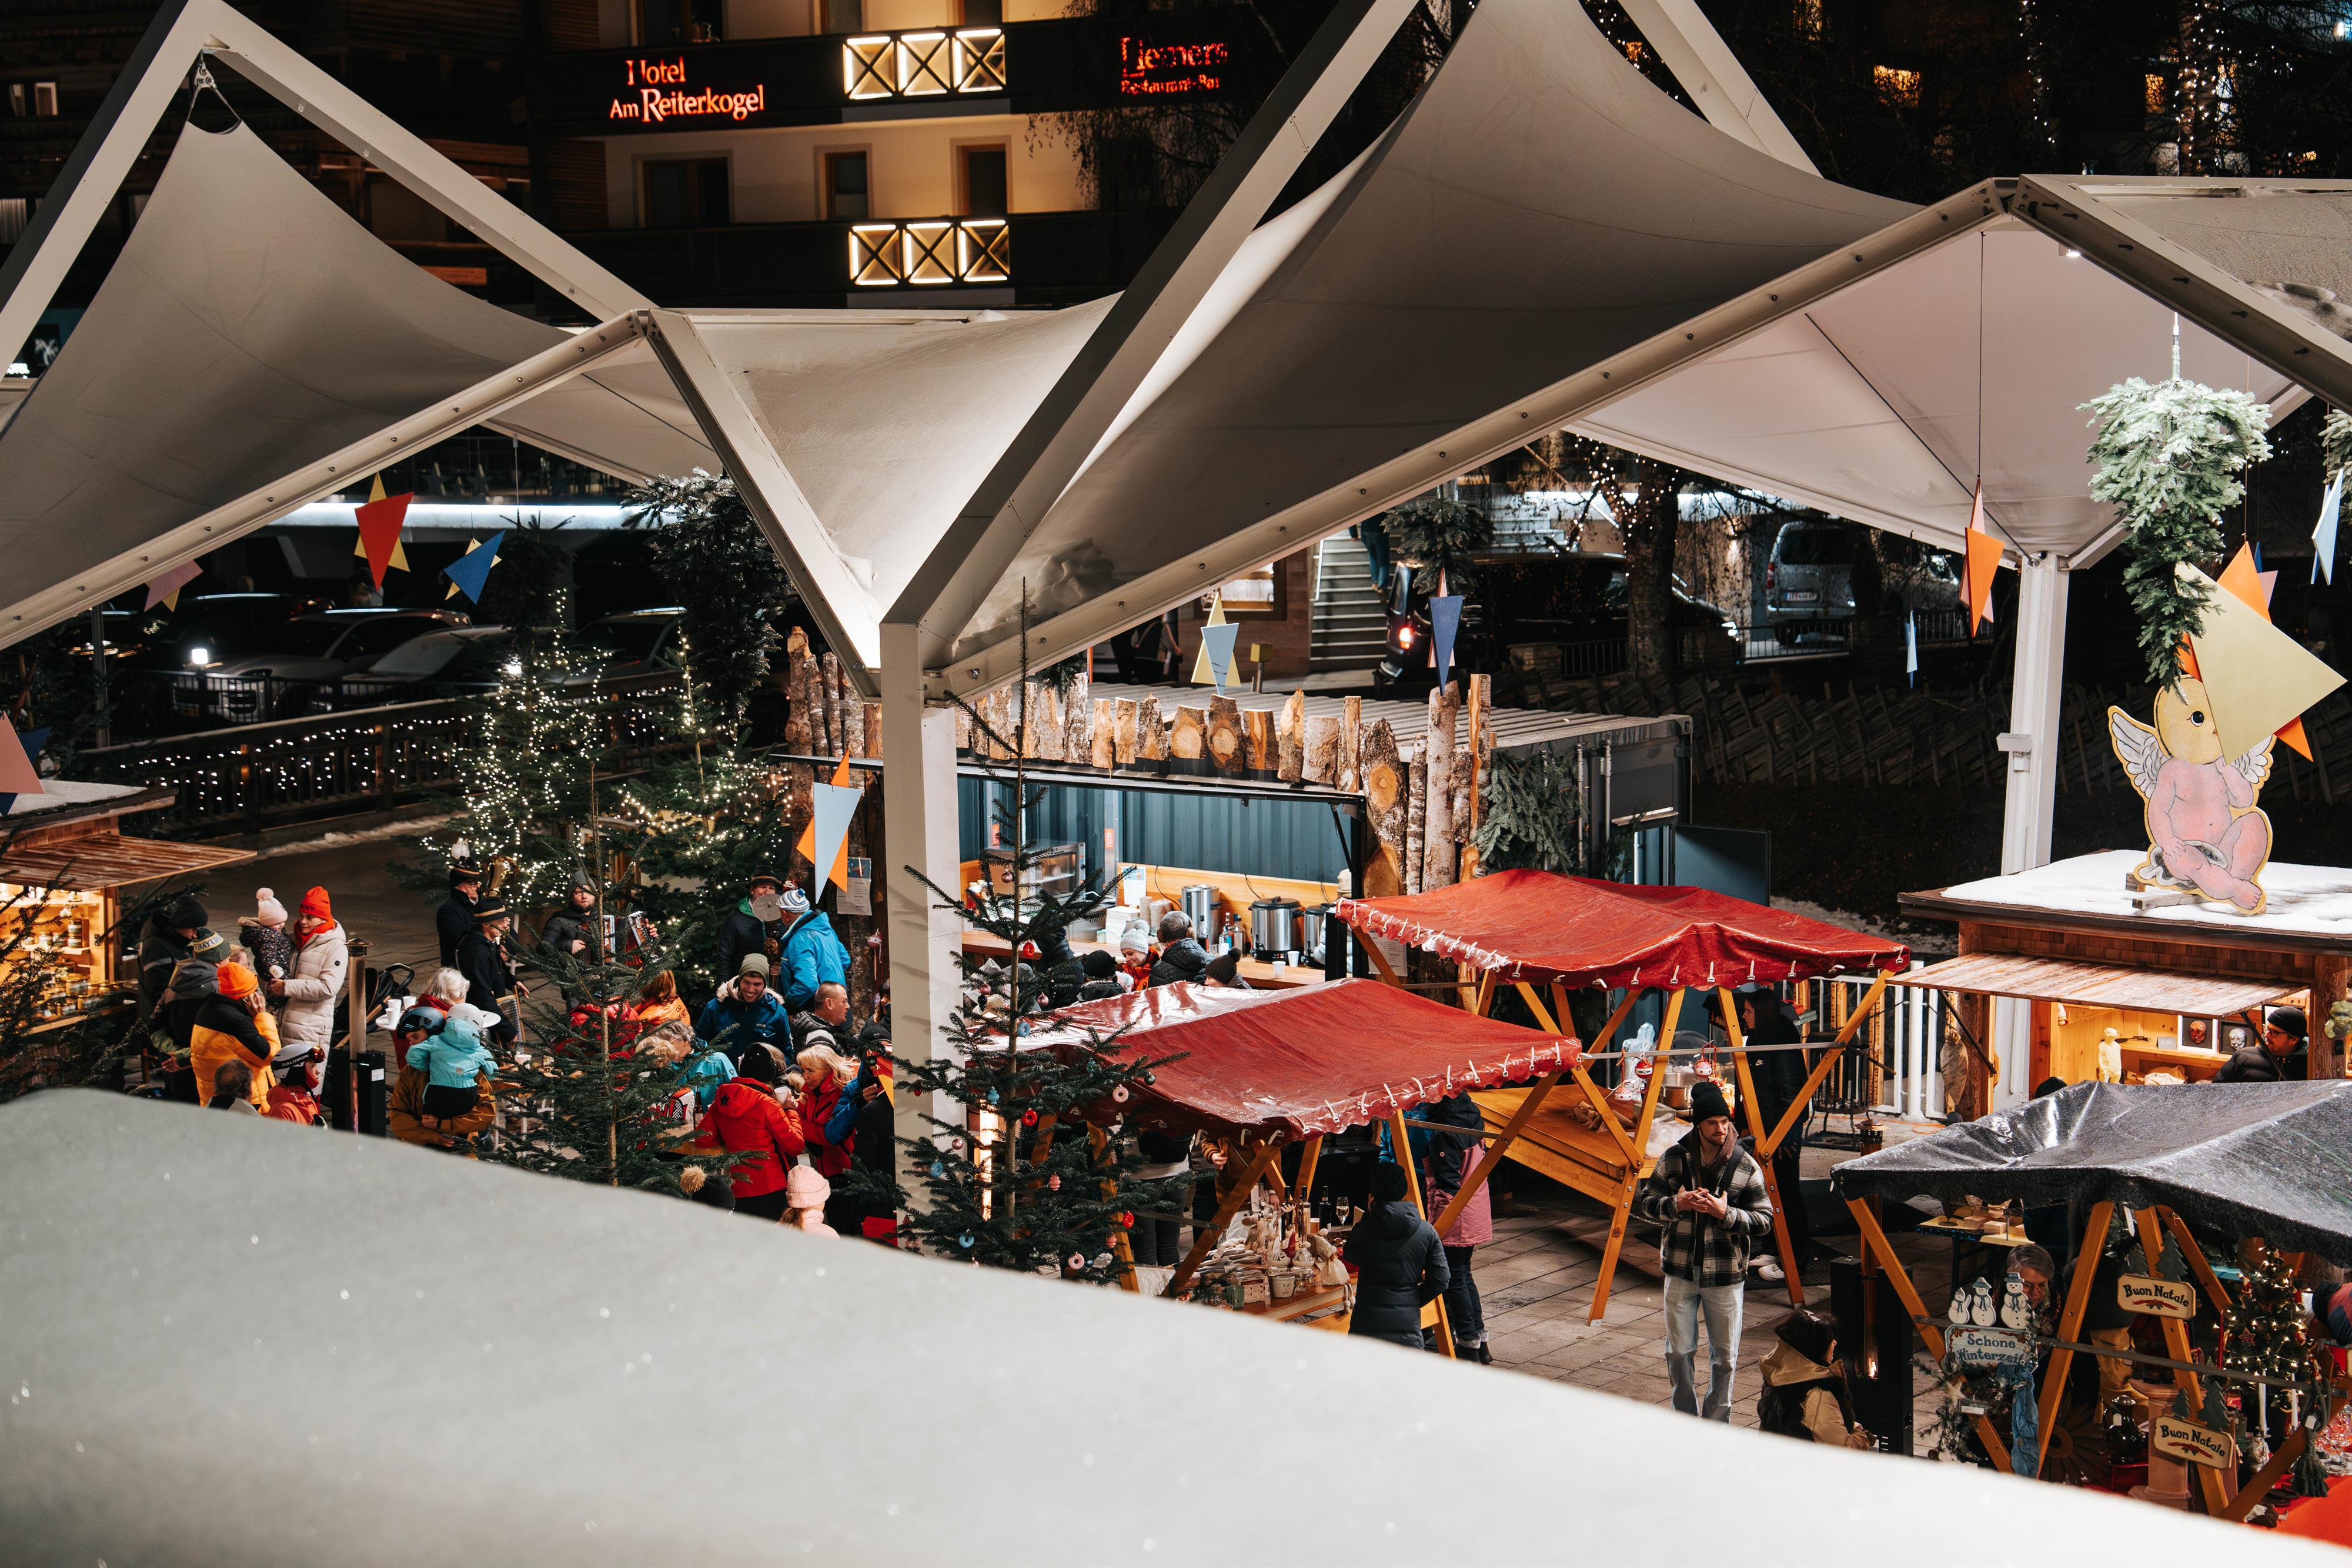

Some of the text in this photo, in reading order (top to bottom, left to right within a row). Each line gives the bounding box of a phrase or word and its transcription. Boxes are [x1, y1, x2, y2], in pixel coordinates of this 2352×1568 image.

[626, 56, 686, 86] Hotel
[610, 84, 766, 122] Am Reiterkogel
[7, 363, 30, 375] OTEL
[282, 1054, 309, 1066] SALOMON
[2123, 1284, 2189, 1307] Buon Natale
[1967, 1333, 2016, 1349] Schöne
[2160, 1425, 2226, 1457] Buon Natale
